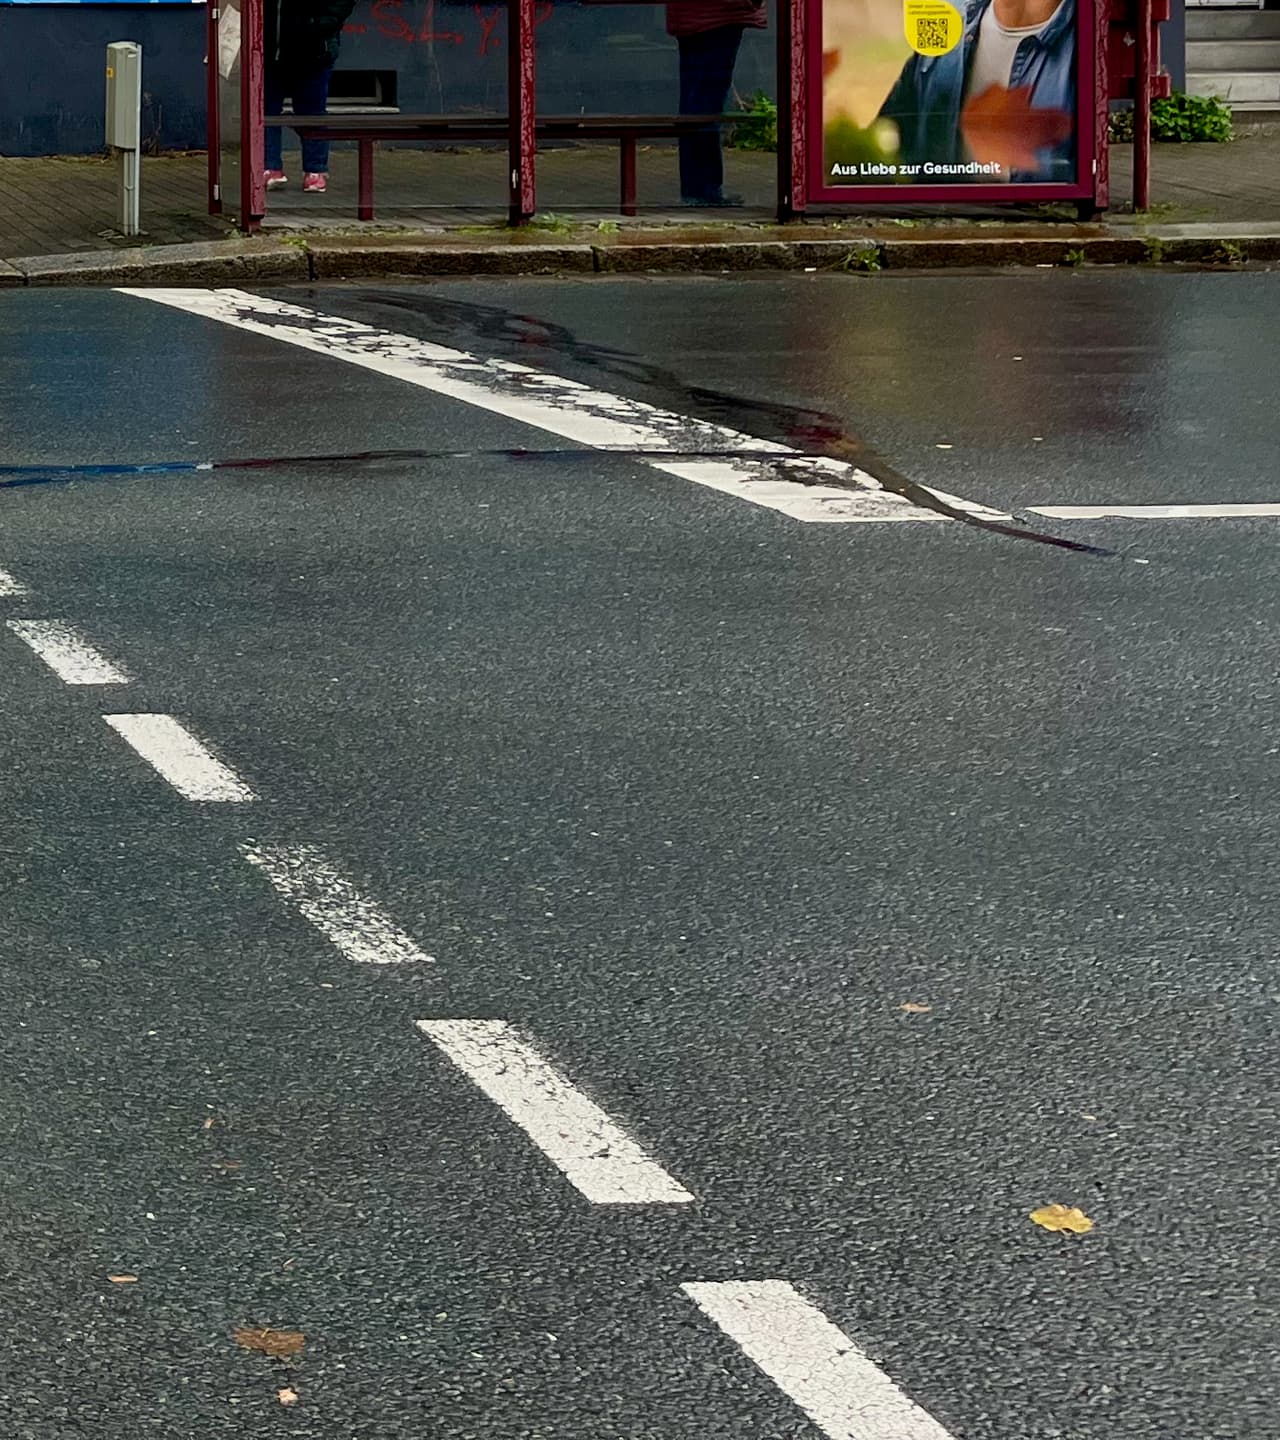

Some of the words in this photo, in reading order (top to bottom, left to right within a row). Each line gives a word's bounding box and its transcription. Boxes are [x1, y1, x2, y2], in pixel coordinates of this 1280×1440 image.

[831, 163, 857, 175] Aus
[860, 162, 897, 175] Liebe
[899, 164, 921, 175] zur
[923, 162, 1001, 175] Gesundheit
